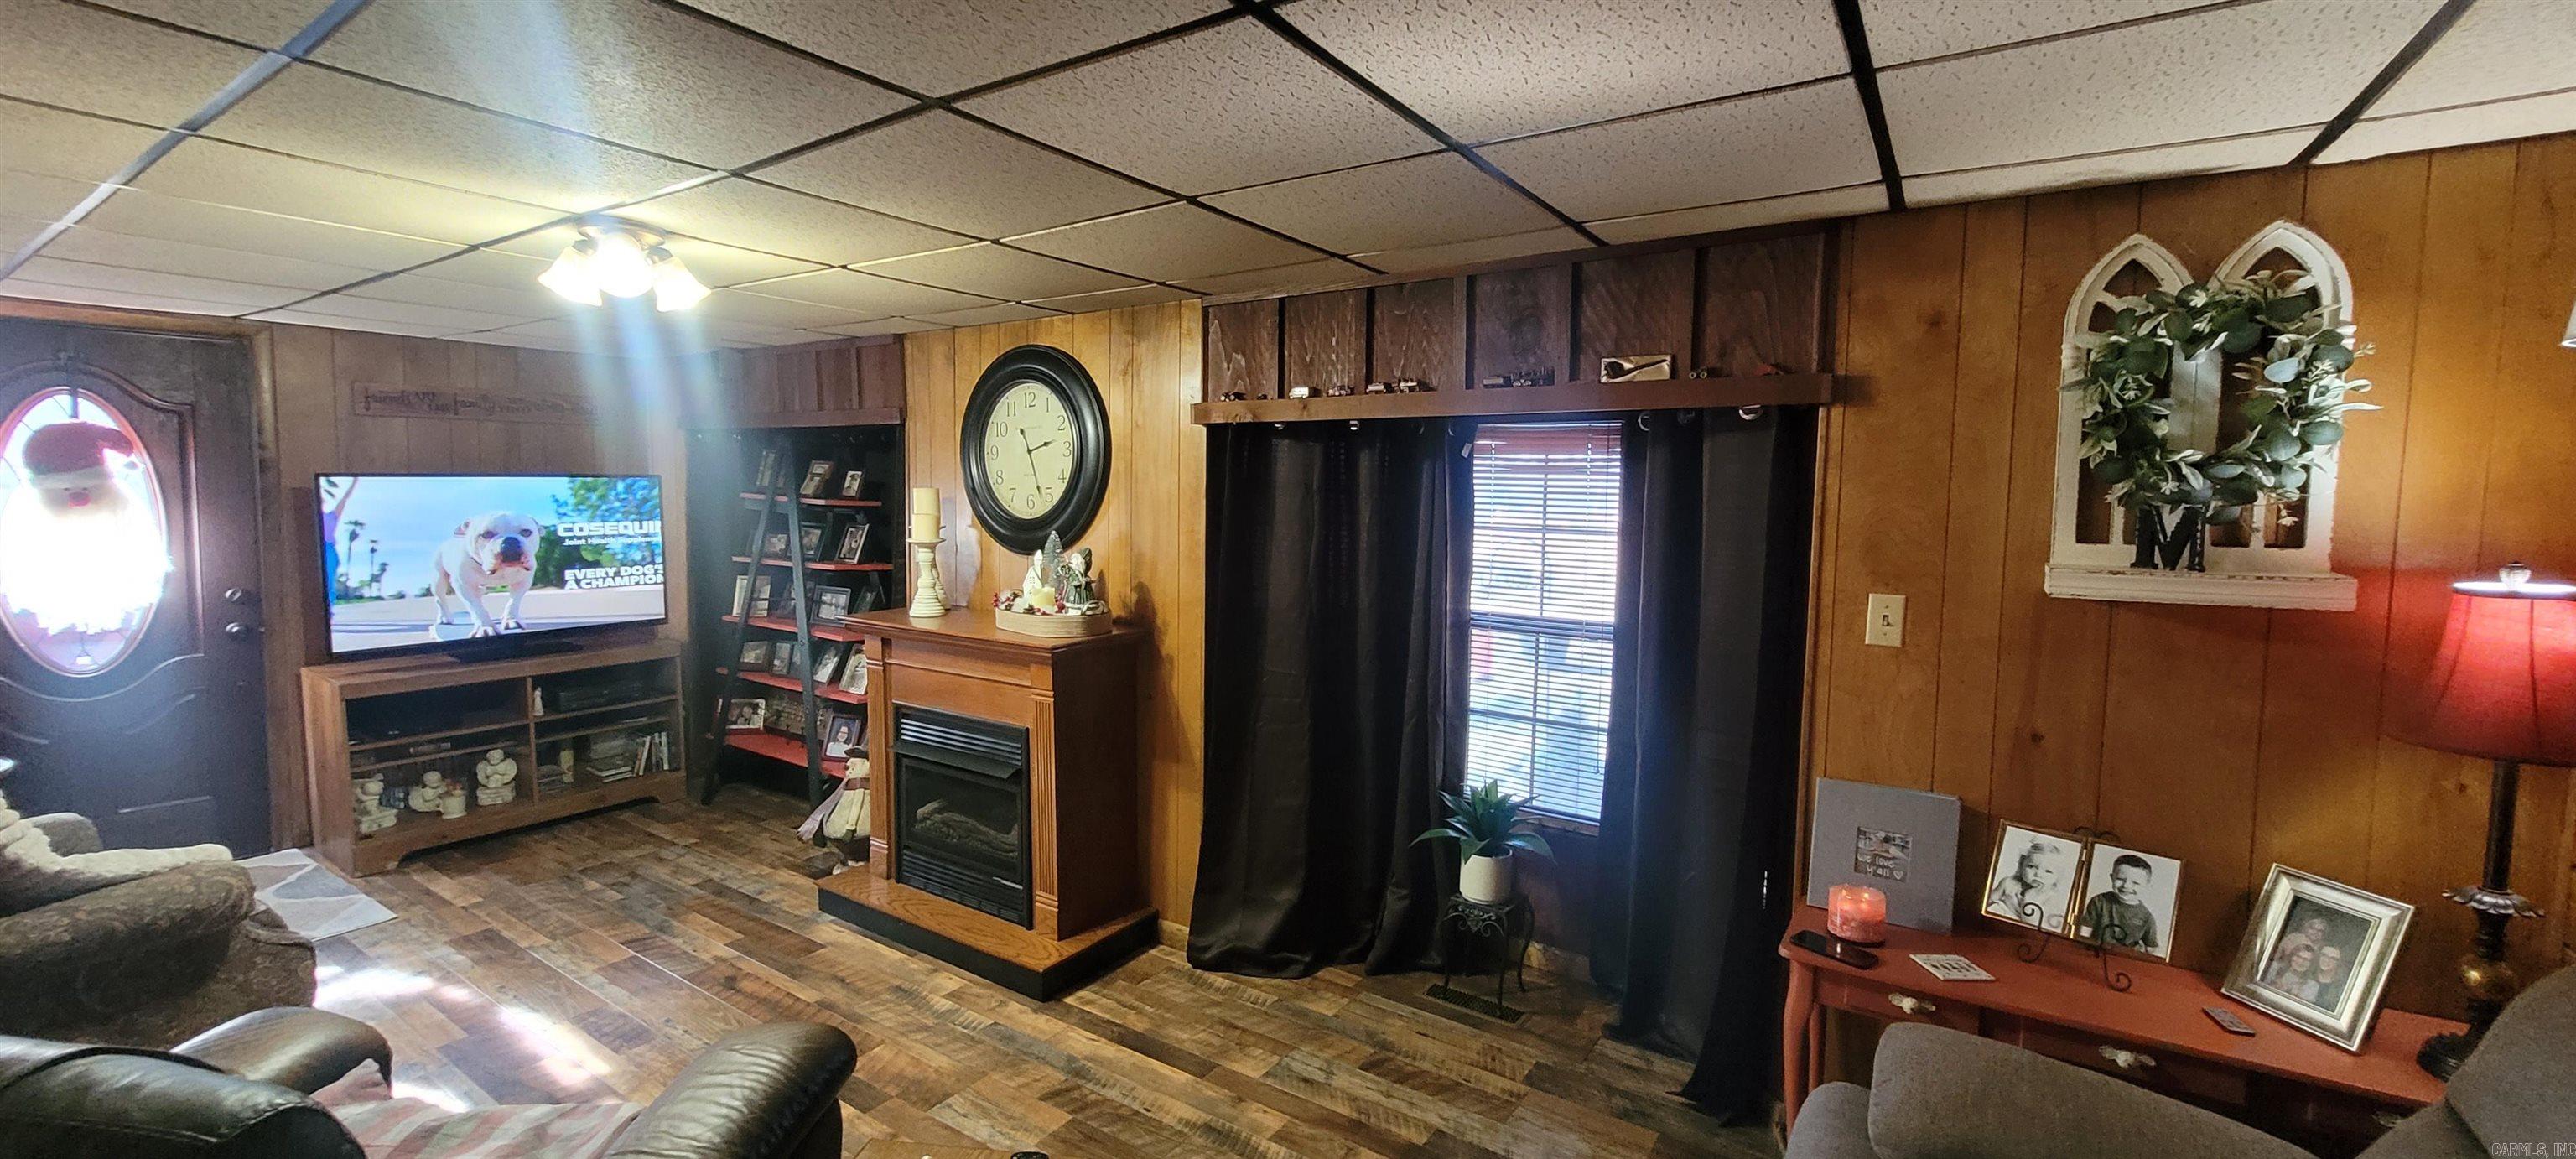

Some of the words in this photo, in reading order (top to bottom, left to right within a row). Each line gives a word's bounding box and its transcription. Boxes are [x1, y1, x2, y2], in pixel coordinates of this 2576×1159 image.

[1023, 392, 1036, 408] 12
[1046, 398, 1051, 413] 1
[1006, 401, 1016, 417] 11
[995, 421, 1009, 438] 10
[1057, 415, 1066, 431] 2
[990, 445, 999, 460] 9
[1062, 441, 1072, 458] 3
[995, 469, 1004, 486] 8
[1057, 468, 1067, 484] 4
[1009, 487, 1017, 503] 7
[1026, 493, 1036, 510] 6
[1045, 487, 1053, 503] 5
[587, 537, 616, 545] Health
[2130, 504, 2206, 572] M
[564, 567, 617, 580] EVERY
[564, 580, 579, 590] A
[1876, 855, 1895, 868] love
